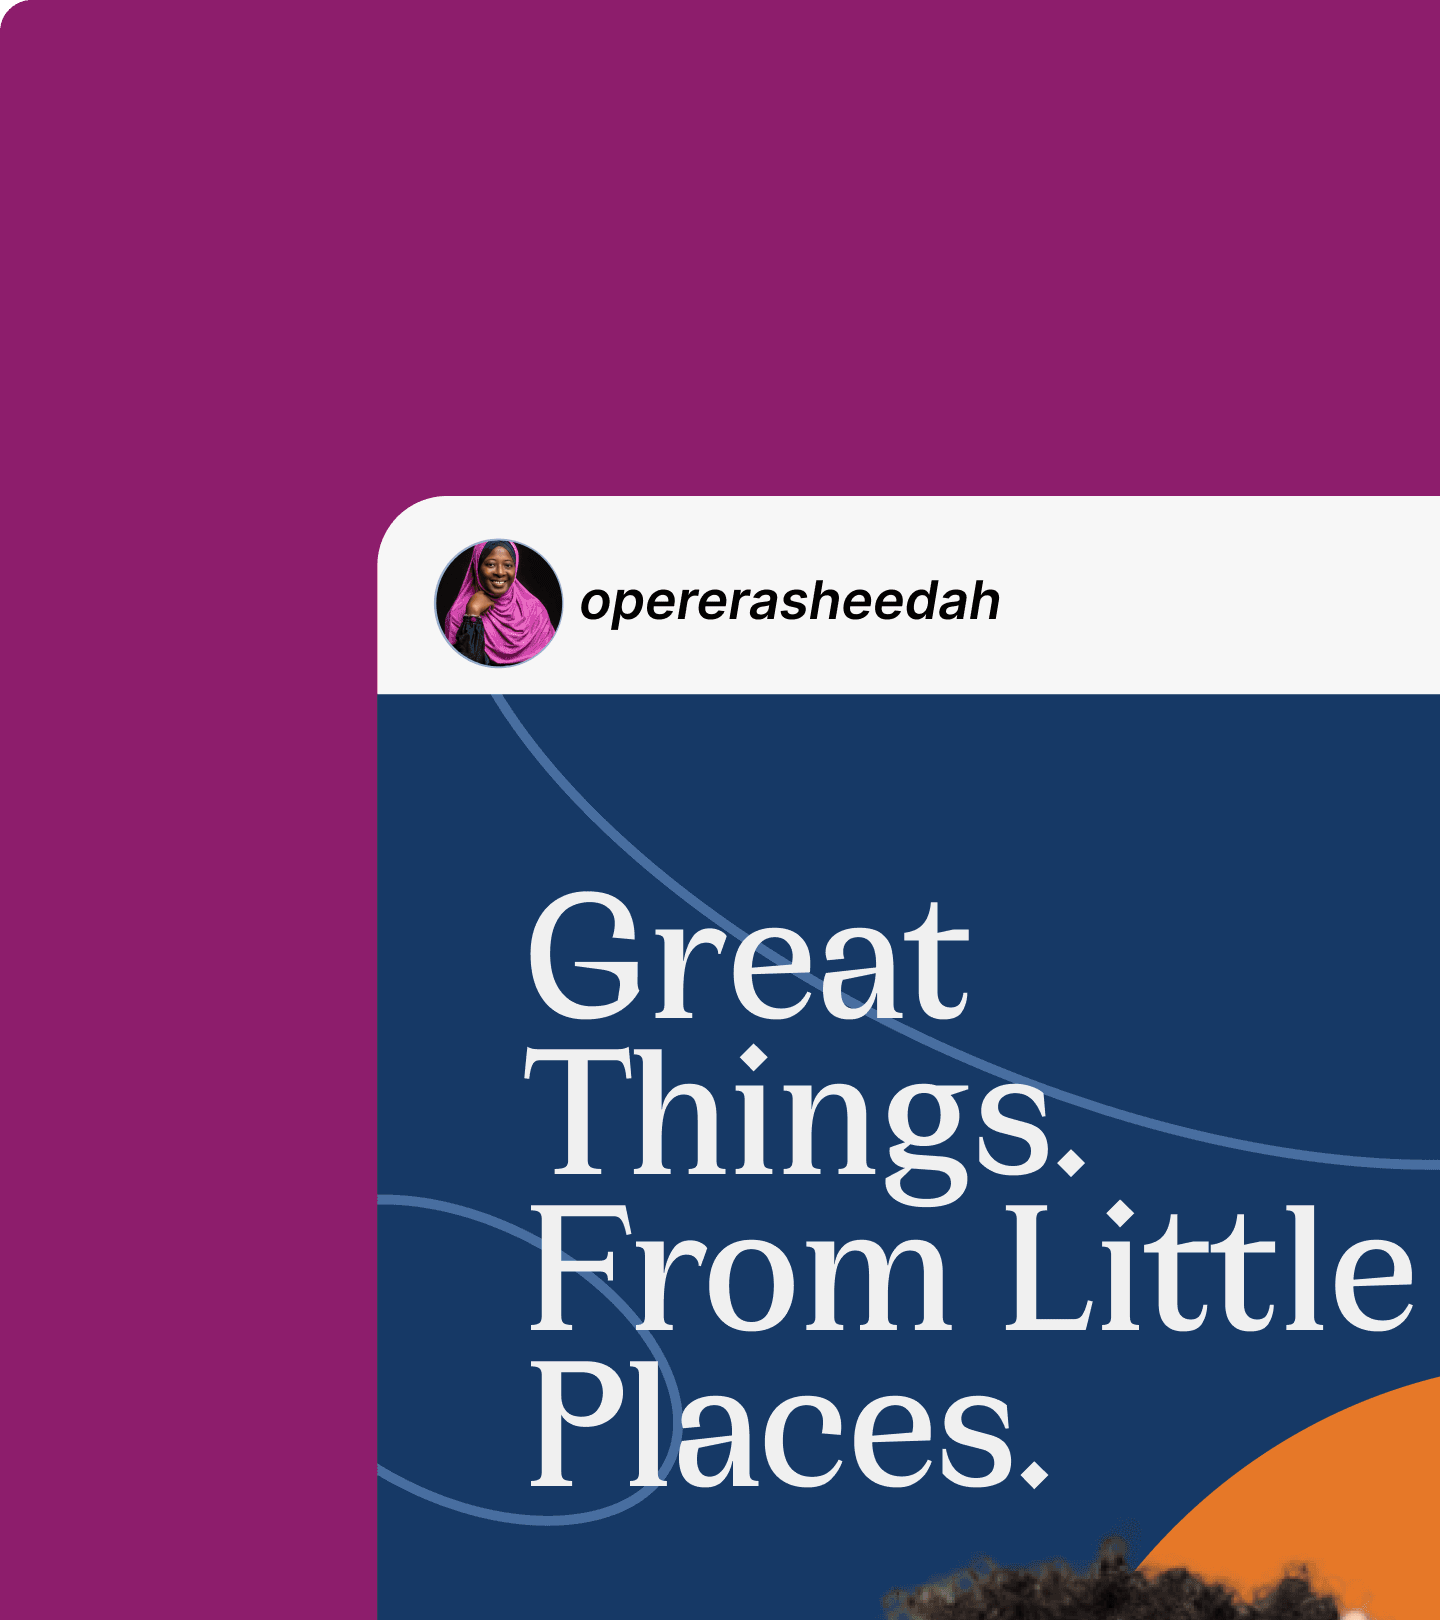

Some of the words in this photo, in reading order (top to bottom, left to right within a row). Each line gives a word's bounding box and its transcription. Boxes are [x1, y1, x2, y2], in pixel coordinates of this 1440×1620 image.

[580, 579, 1000, 631] opererasheedah
[530, 891, 969, 1020] Great
[524, 1043, 1086, 1208] Things.
[530, 1203, 953, 1332] From
[1005, 1199, 1413, 1332] Little
[530, 1360, 1049, 1490] Places.
